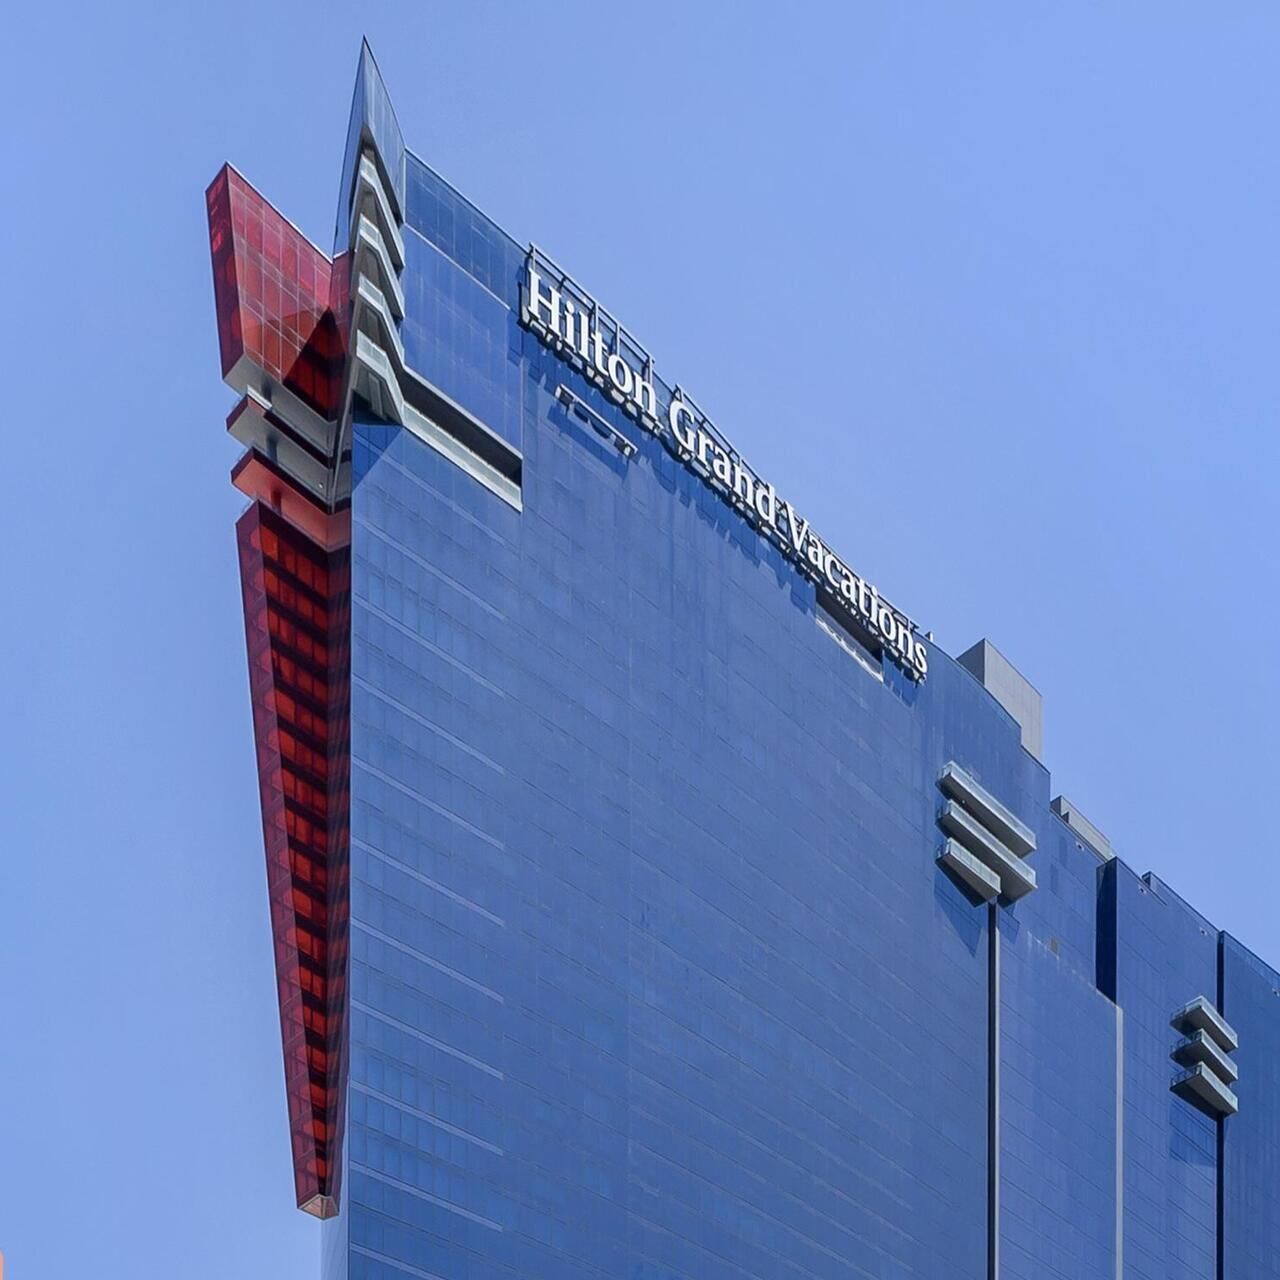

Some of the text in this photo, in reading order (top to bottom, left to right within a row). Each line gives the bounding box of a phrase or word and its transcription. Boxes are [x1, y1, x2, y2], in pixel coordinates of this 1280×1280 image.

[528, 267, 929, 676] Hilton Grand Vacations
